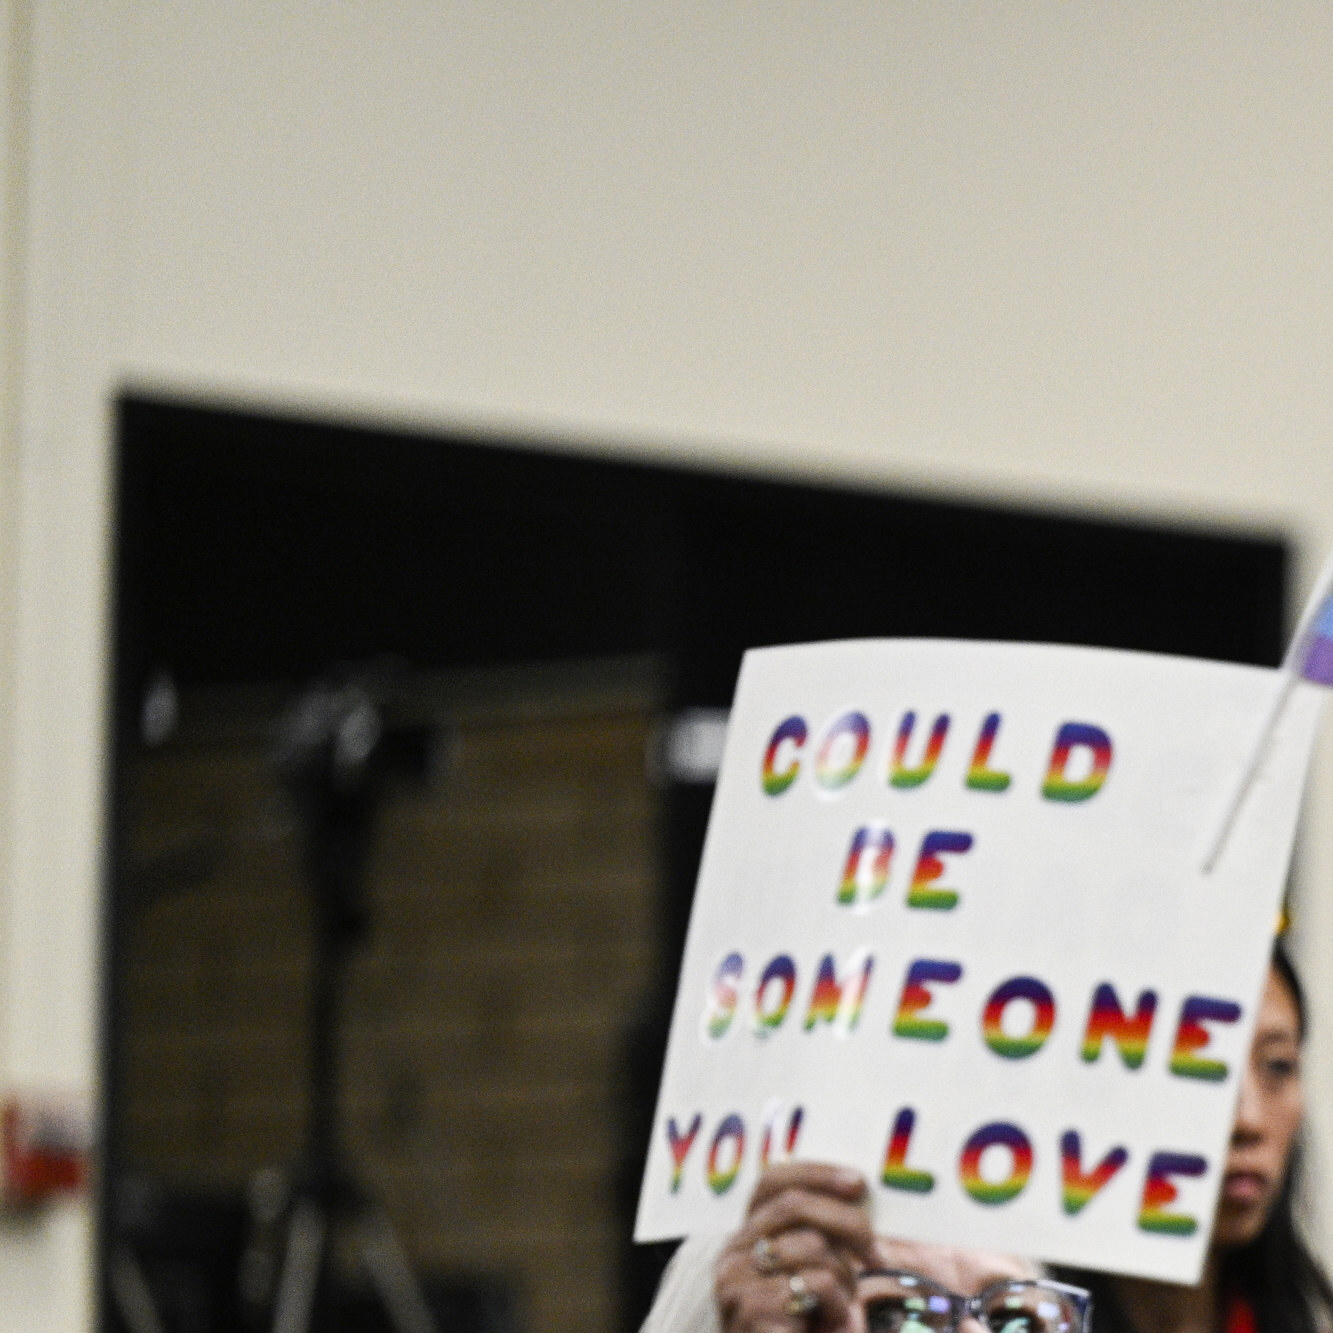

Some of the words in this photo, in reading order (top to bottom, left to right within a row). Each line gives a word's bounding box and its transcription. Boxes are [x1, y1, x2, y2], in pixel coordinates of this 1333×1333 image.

[760, 709, 1115, 804] COULD
[836, 825, 974, 911] BE
[705, 951, 1243, 1083] SOMEONE
[880, 1107, 1208, 1237] LOVE
